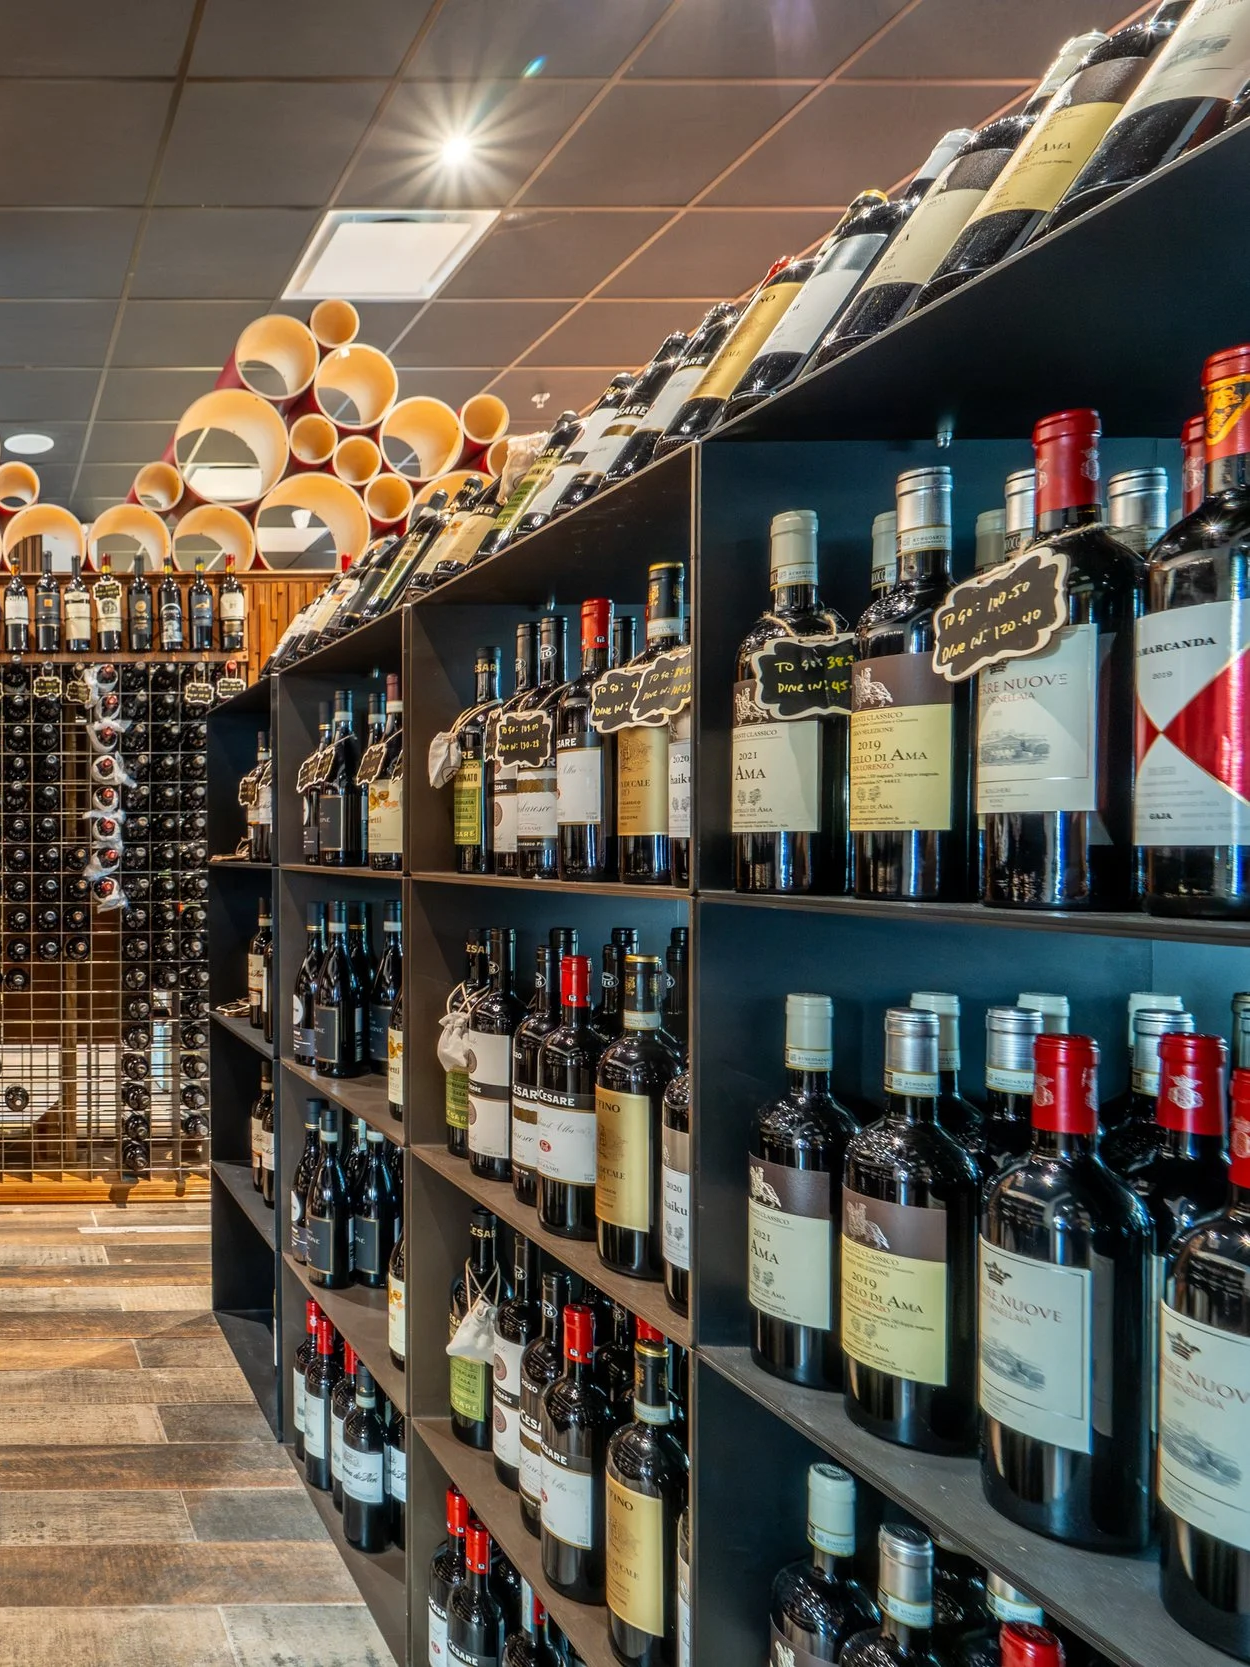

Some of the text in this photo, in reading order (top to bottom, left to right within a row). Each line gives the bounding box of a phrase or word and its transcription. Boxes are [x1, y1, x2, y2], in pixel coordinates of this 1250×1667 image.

[774, 661, 795, 673] TO
[1003, 672, 1068, 692] NUOVE
[857, 740, 881, 751] 2019
[738, 751, 758, 761] 2021
[891, 748, 928, 761] AMA
[735, 765, 766, 781] AMA
[750, 1238, 780, 1265] AMA
[851, 1271, 878, 1290] 2019
[887, 1295, 924, 1314] AMA
